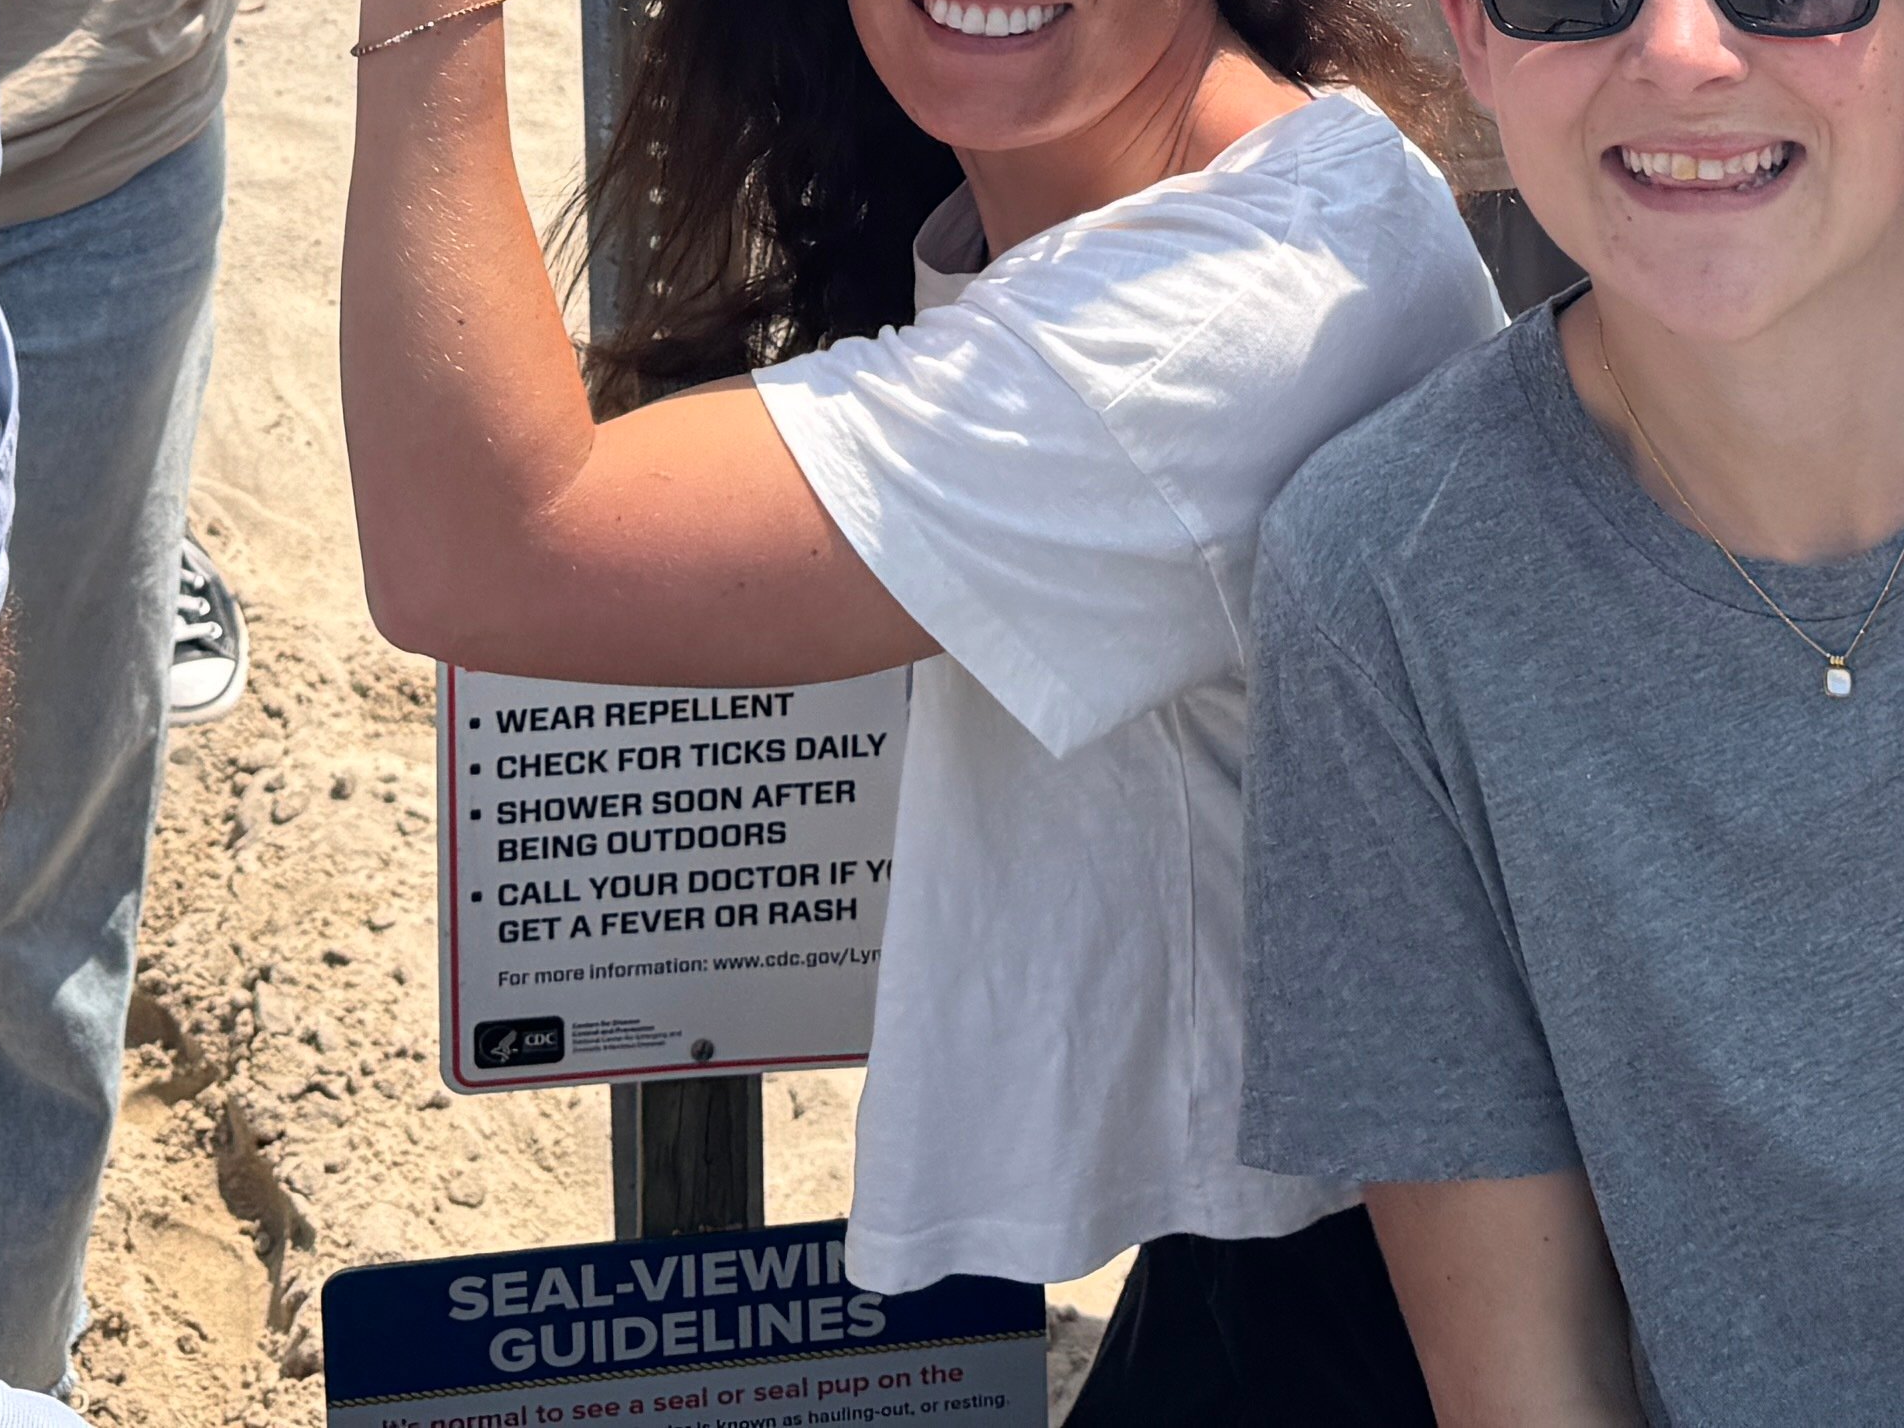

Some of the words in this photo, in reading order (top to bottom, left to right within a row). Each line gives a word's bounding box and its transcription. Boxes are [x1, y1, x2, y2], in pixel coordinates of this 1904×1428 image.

[496, 705, 594, 733] WEAR
[606, 692, 794, 727] REPELLENT
[497, 750, 608, 779] CHECK
[619, 746, 680, 771] FOR
[690, 739, 785, 767] TICKS
[796, 733, 886, 760] DAILY
[498, 793, 641, 824] SHOWER
[653, 787, 741, 814] SOON
[752, 780, 855, 808] AFTER
[499, 834, 597, 862] BEING
[608, 822, 786, 854] OUTDOORS
[498, 880, 580, 906] CALL
[589, 873, 677, 899] YOUR
[689, 864, 819, 893] DOCTOR
[831, 861, 857, 884] IF
[499, 917, 561, 943] GET
[570, 916, 591, 938] A
[602, 907, 704, 935] FEVER
[716, 904, 757, 927] OR
[769, 898, 856, 924] RASH
[499, 971, 529, 987] For
[535, 969, 584, 984] more
[590, 958, 707, 979] information:
[488, 1293, 887, 1372] GUIDELINES
[572, 1396, 620, 1420] see
[628, 1395, 645, 1414] a
[654, 1387, 709, 1412] seal
[718, 1385, 747, 1406] or
[754, 1378, 809, 1402] seal
[817, 1375, 870, 1402] pup
[879, 1370, 912, 1390] on
[921, 1363, 964, 1385] the
